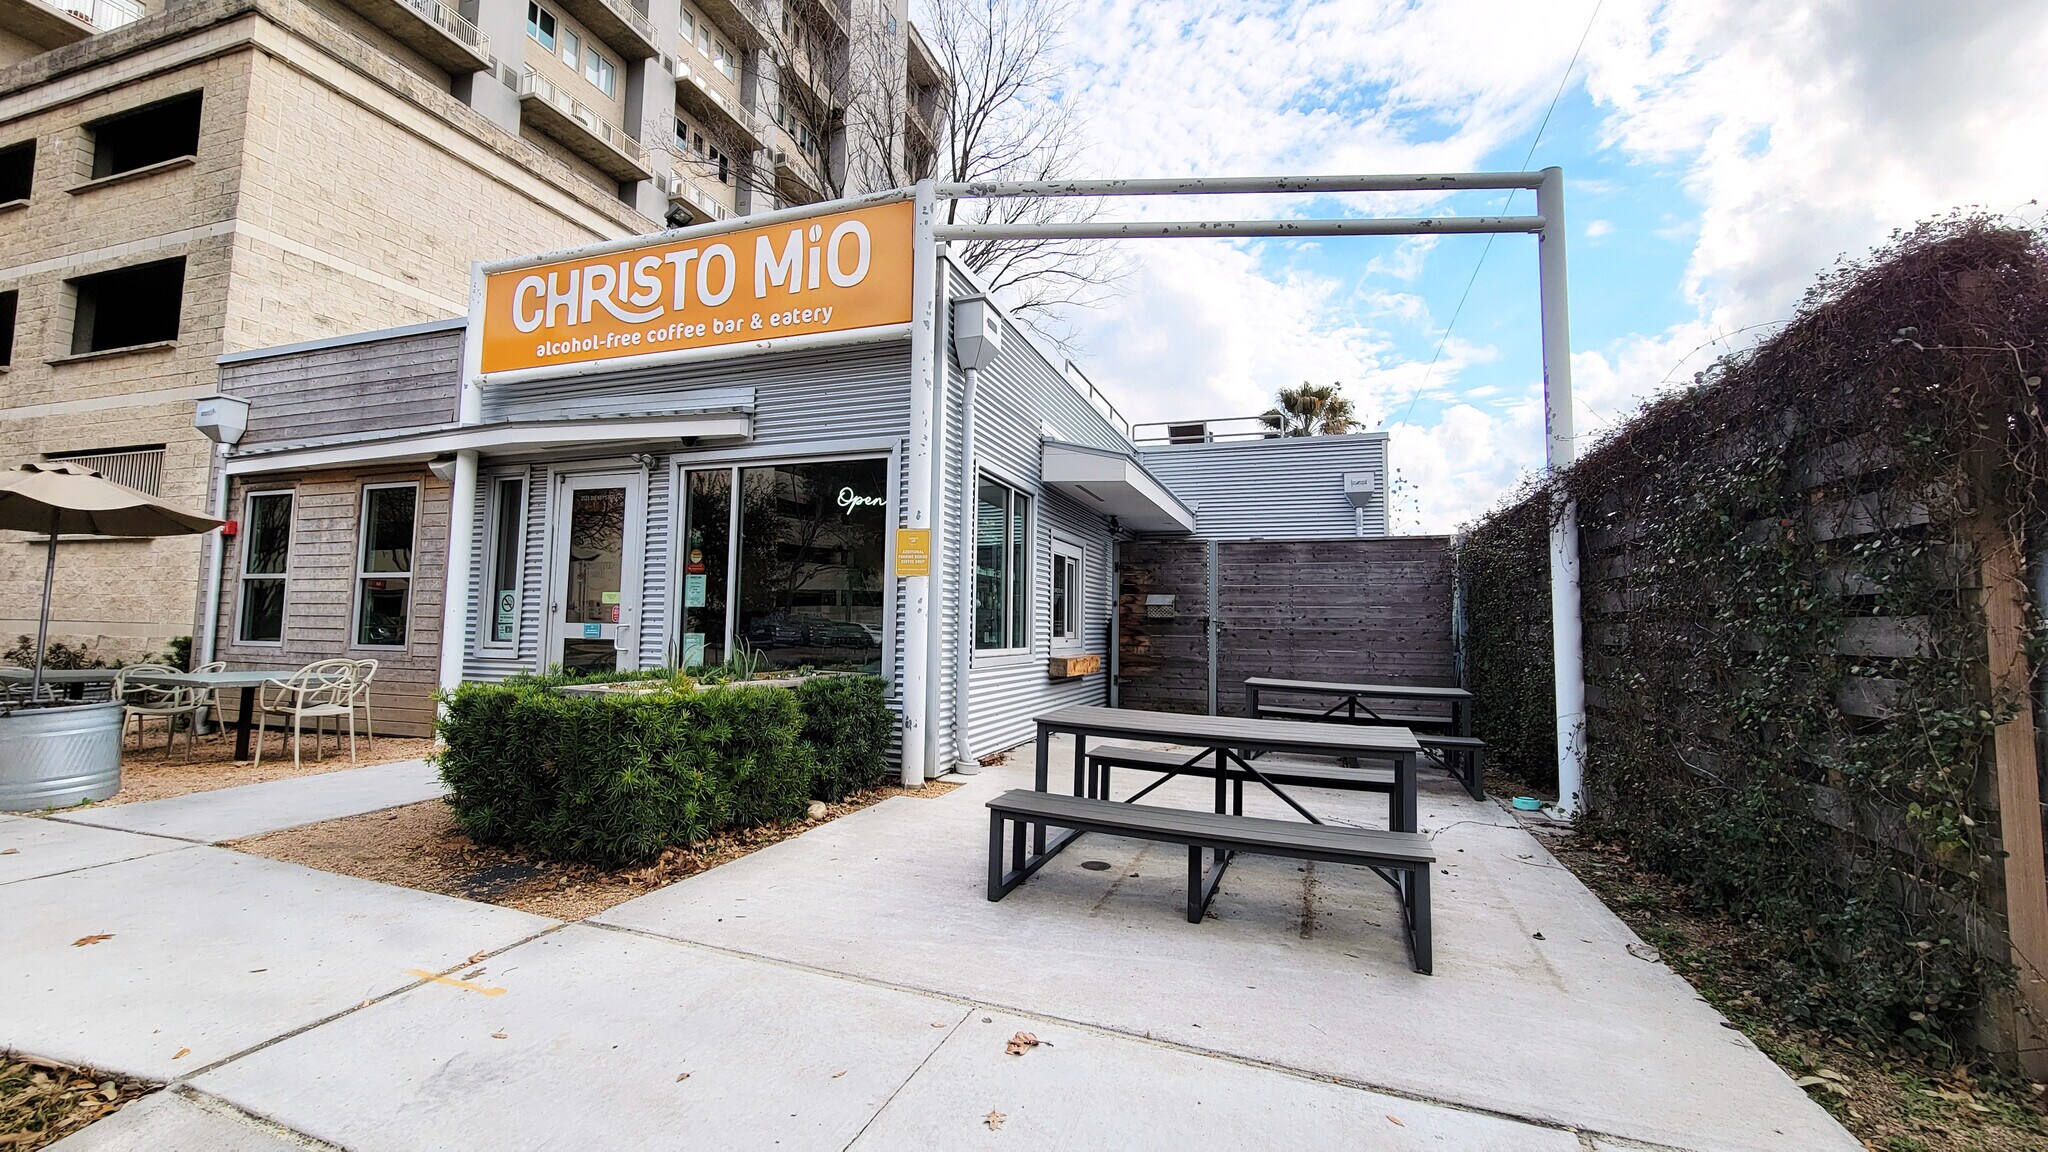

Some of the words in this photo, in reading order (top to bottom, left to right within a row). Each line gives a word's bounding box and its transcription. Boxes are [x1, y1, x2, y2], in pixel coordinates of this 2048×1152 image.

[512, 243, 736, 334] CHRISTO
[536, 332, 642, 358] alcohol-free
[646, 322, 706, 344] coffee
[712, 317, 744, 335] bar
[749, 312, 763, 330] &
[769, 305, 834, 325] eatery
[836, 486, 888, 516] Open
